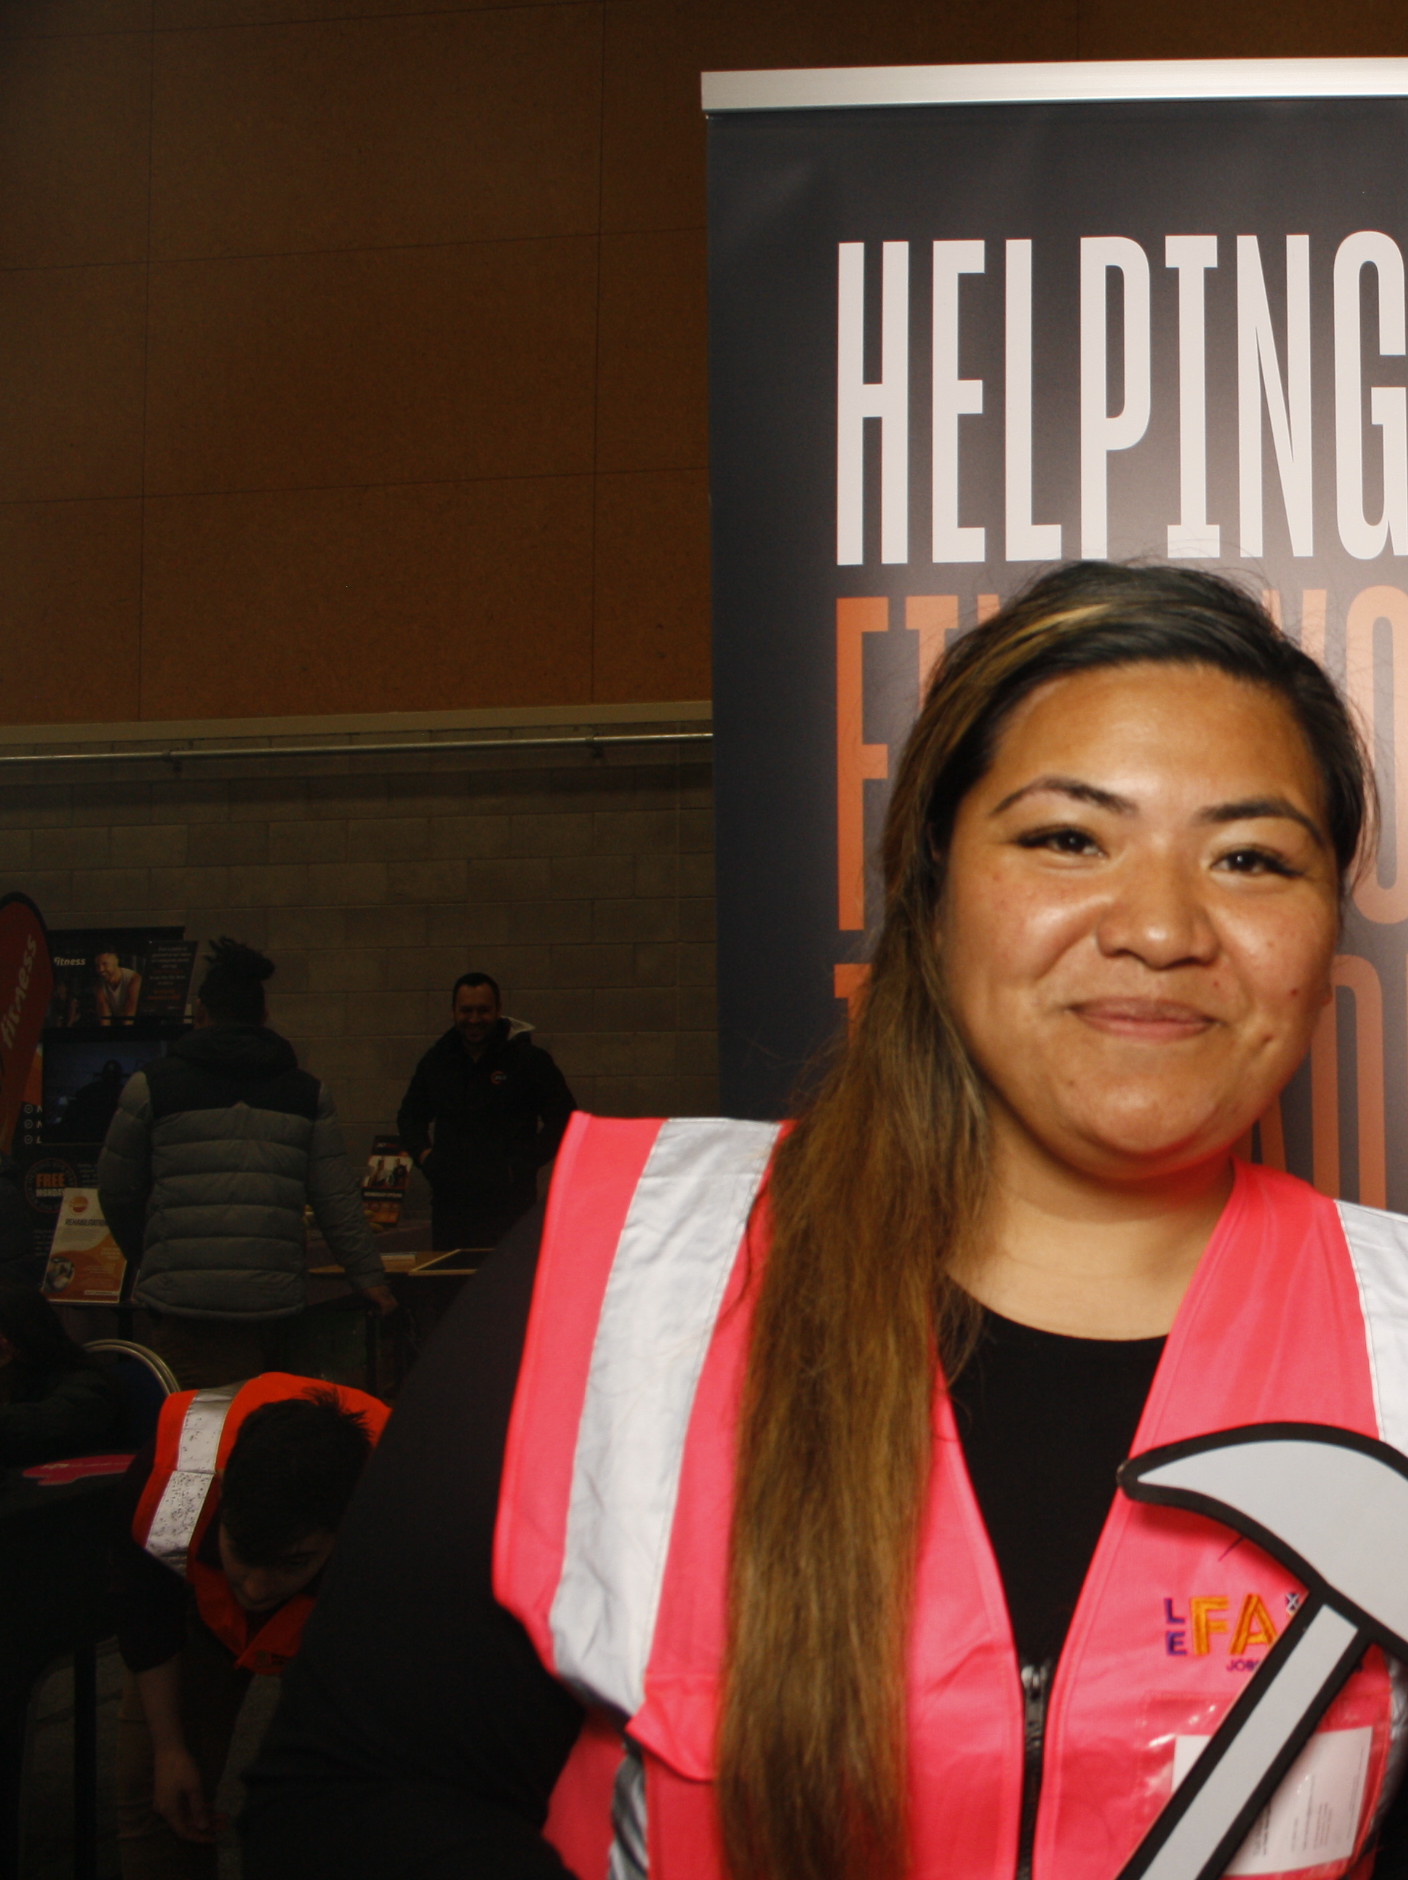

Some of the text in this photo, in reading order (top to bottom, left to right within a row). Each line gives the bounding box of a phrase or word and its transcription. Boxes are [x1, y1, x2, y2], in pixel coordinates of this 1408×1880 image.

[837, 230, 1408, 565] HELPING
[1, 934, 37, 1049] fitness
[36, 1173, 65, 1187] FREE
[1190, 1593, 1299, 1656] FA
